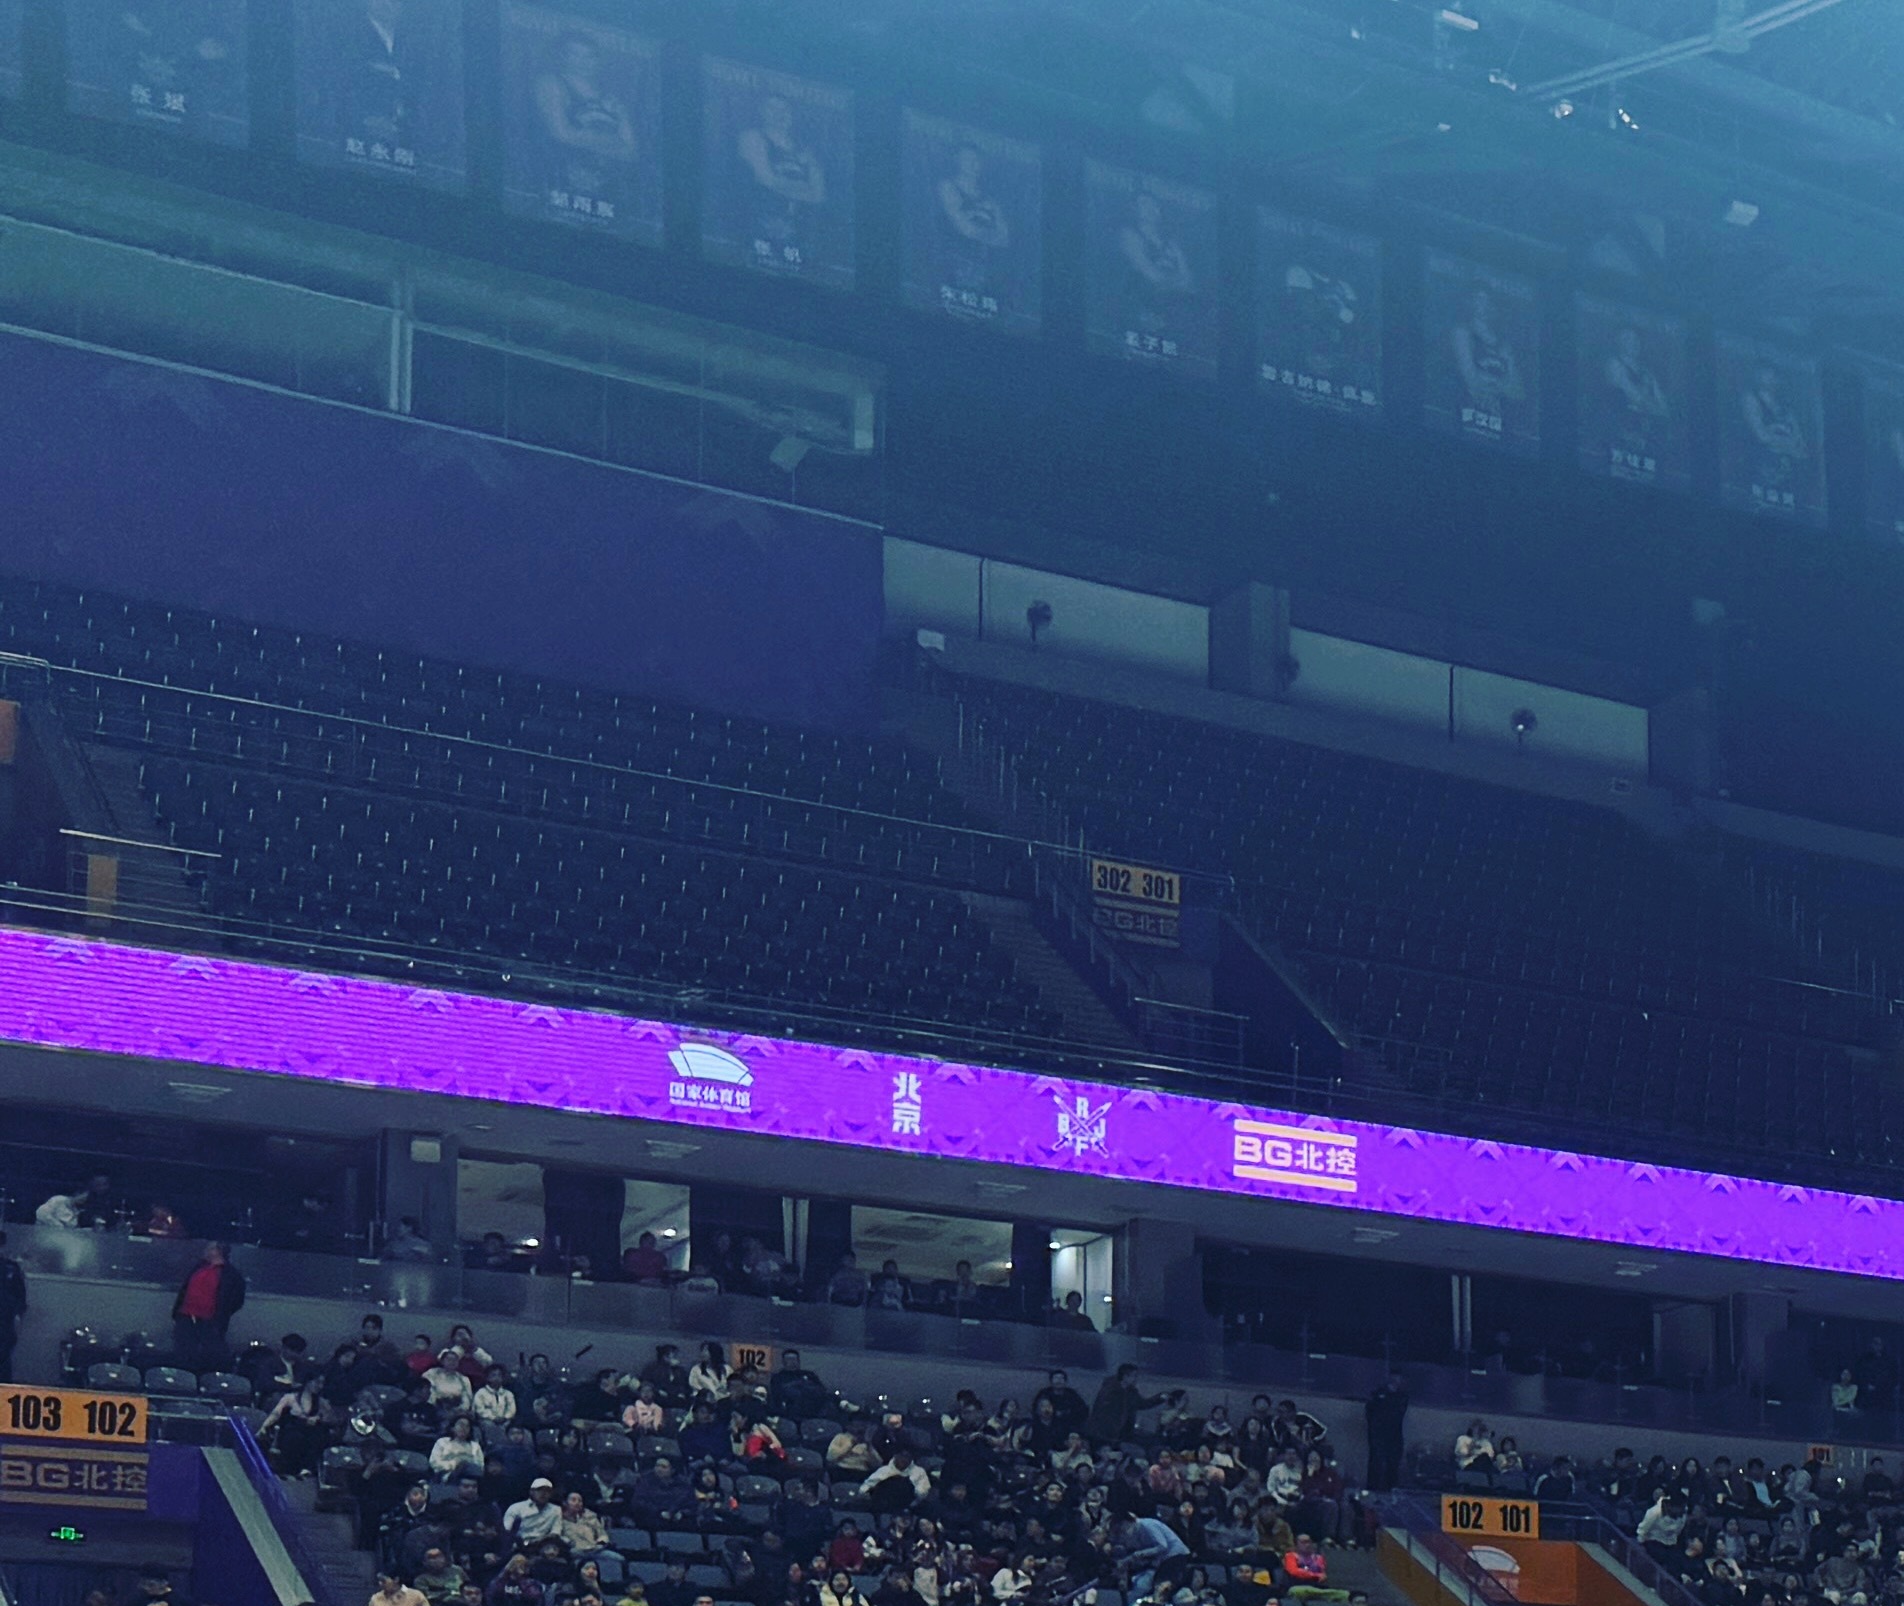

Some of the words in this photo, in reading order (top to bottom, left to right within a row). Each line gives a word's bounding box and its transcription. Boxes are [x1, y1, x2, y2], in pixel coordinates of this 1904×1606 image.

[1097, 865, 1131, 893] 302
[1142, 870, 1174, 900] 301
[891, 1071, 922, 1137] 北京
[1233, 1135, 1357, 1177] BG北控
[7, 1394, 62, 1432] 103
[82, 1401, 137, 1437] 102
[0, 1460, 147, 1492] BG北控
[1448, 1501, 1484, 1530] 102
[1500, 1505, 1531, 1533] 101
